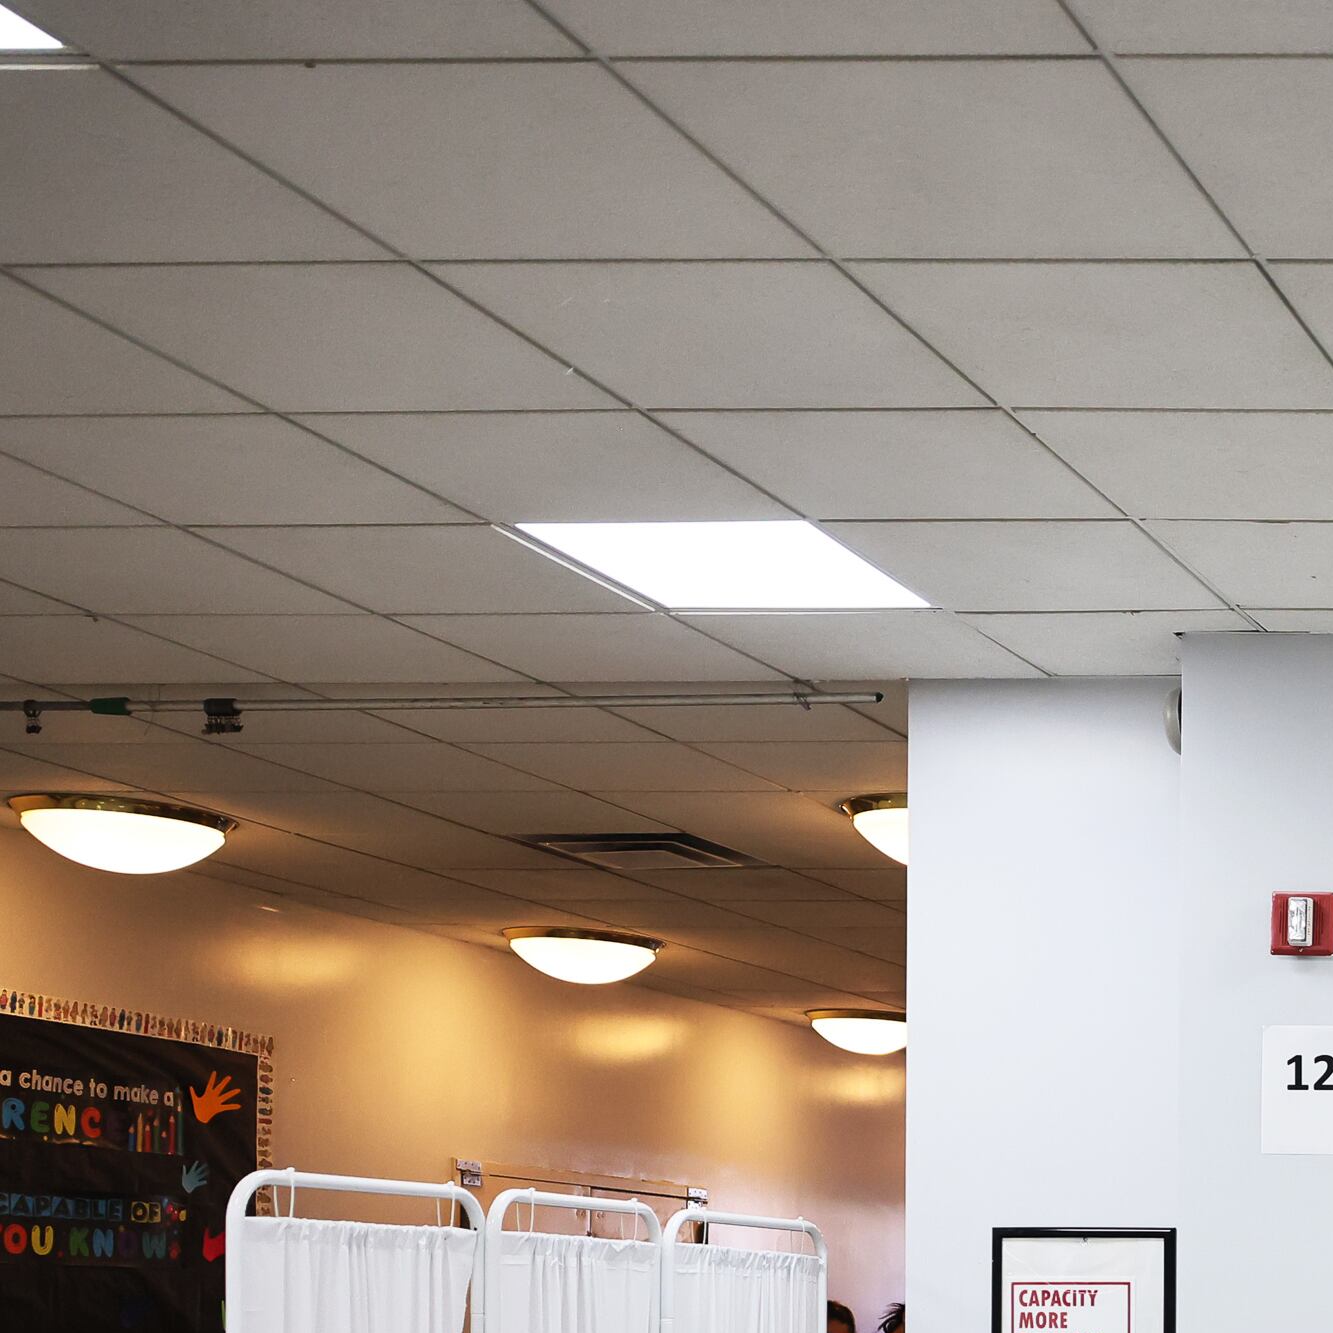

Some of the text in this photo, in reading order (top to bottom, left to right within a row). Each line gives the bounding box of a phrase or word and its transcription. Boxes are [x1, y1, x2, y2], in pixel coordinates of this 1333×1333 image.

[0, 1069, 175, 1107] a chance to make a
[131, 1201, 162, 1223] OF
[0, 1222, 54, 1256] OU
[1018, 1289, 1099, 1307] CAPACITY
[1018, 1311, 1068, 1329] MORE
